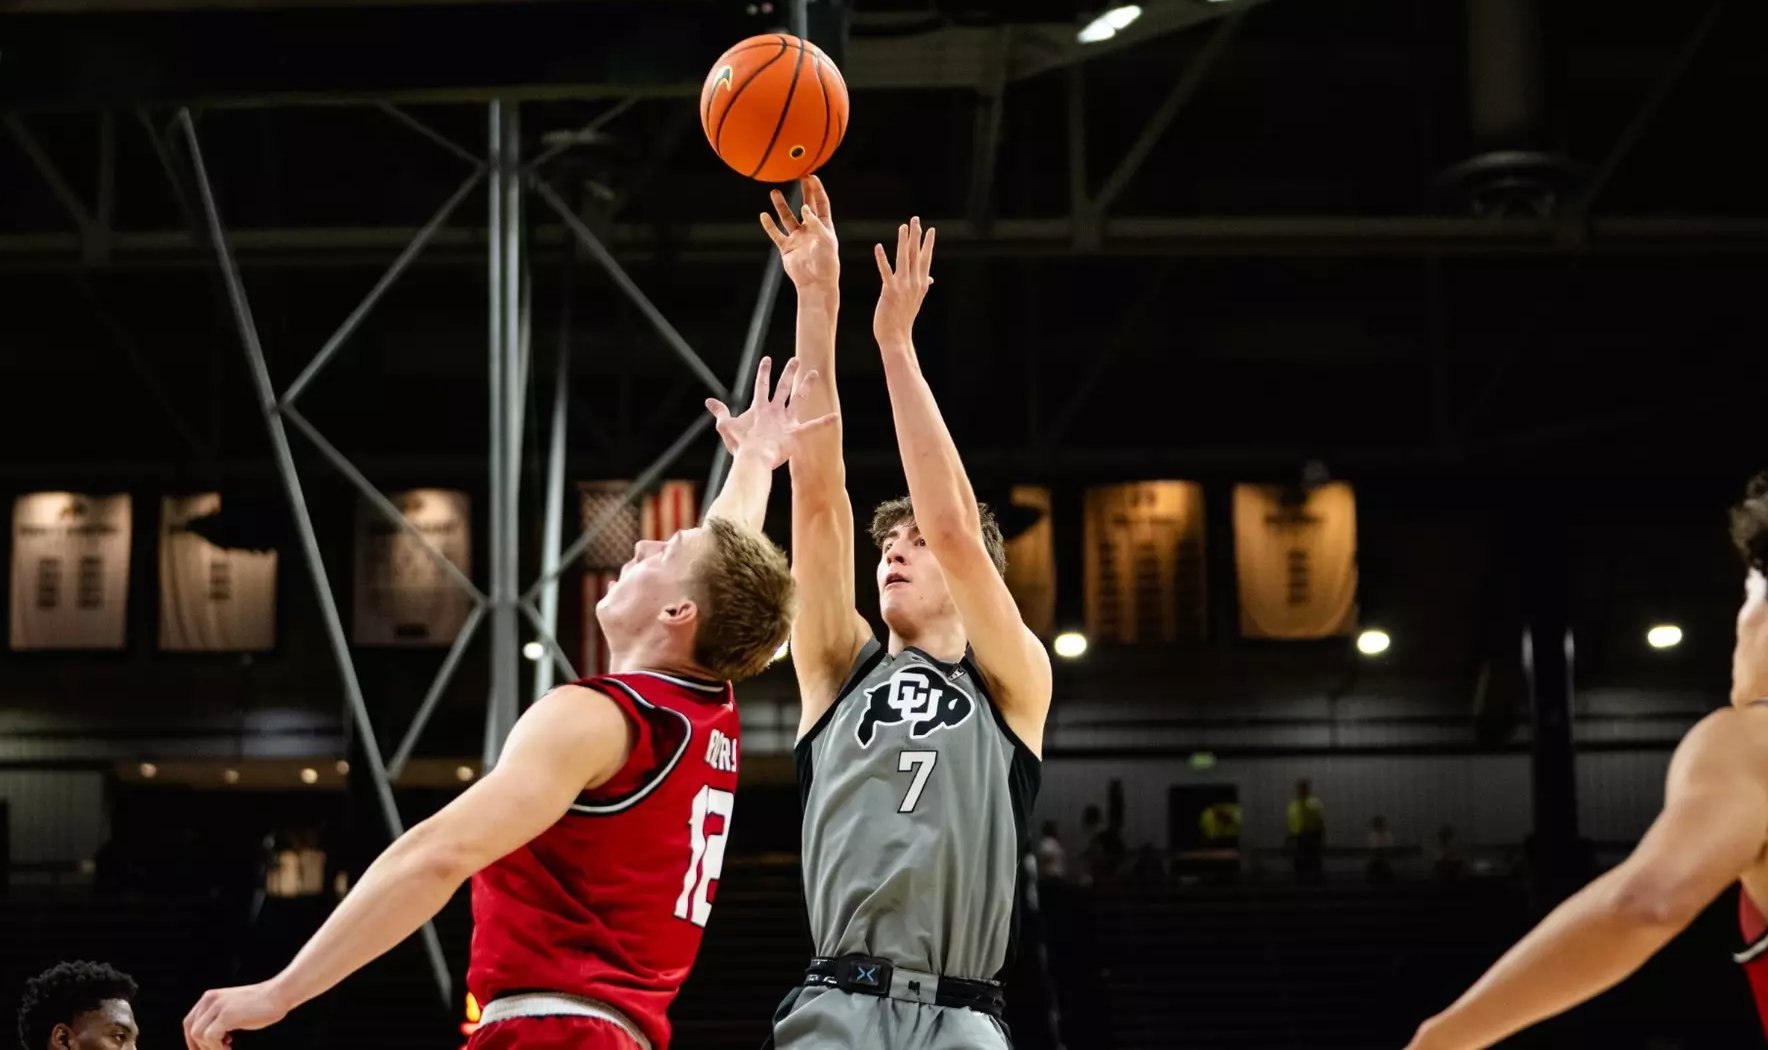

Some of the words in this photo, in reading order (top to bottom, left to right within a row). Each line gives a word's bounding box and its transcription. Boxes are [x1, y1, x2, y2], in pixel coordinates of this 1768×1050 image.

[887, 671, 943, 722] CU
[898, 749, 939, 814] 7
[673, 784, 735, 928] 12
